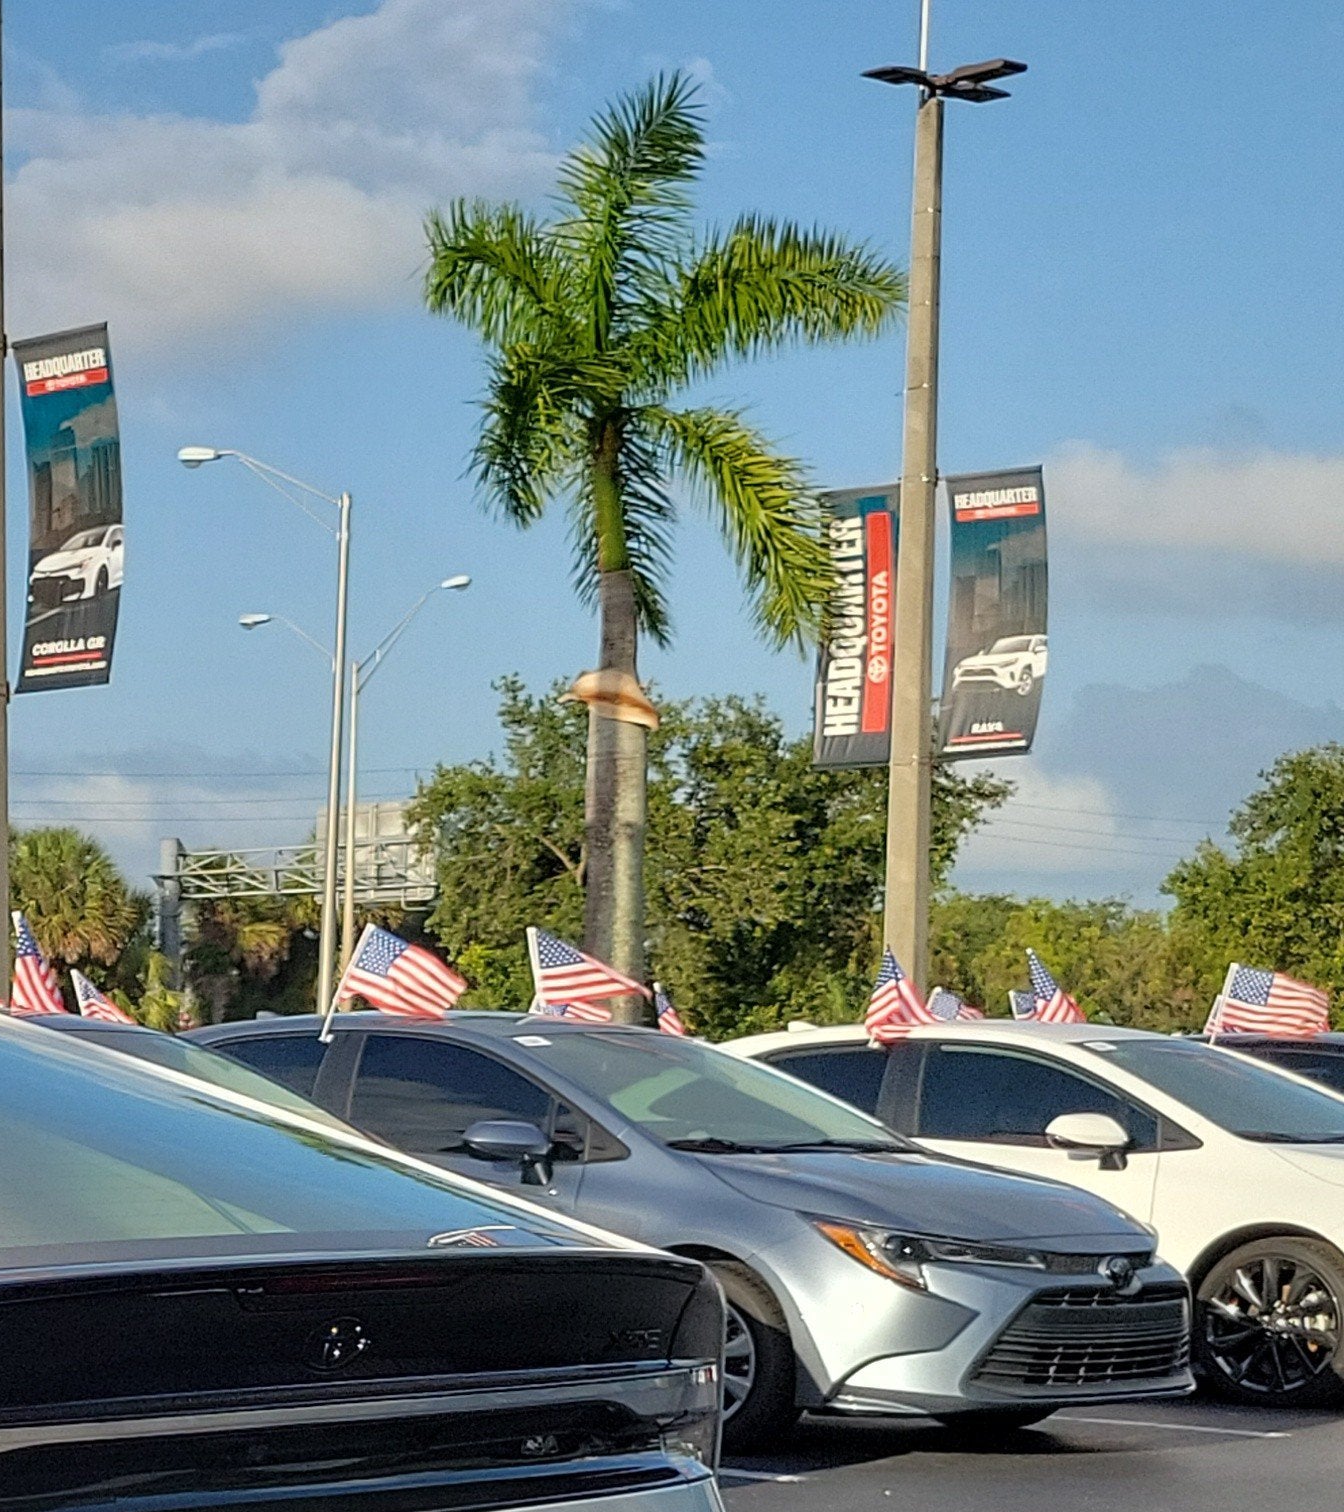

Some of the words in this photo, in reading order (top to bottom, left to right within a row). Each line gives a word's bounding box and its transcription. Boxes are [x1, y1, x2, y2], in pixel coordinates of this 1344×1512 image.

[23, 348, 108, 382] HEADQUARTER
[954, 486, 1038, 509] HEADQUARTER
[869, 570, 890, 653] TOYOTA
[32, 637, 86, 656] COROLLA
